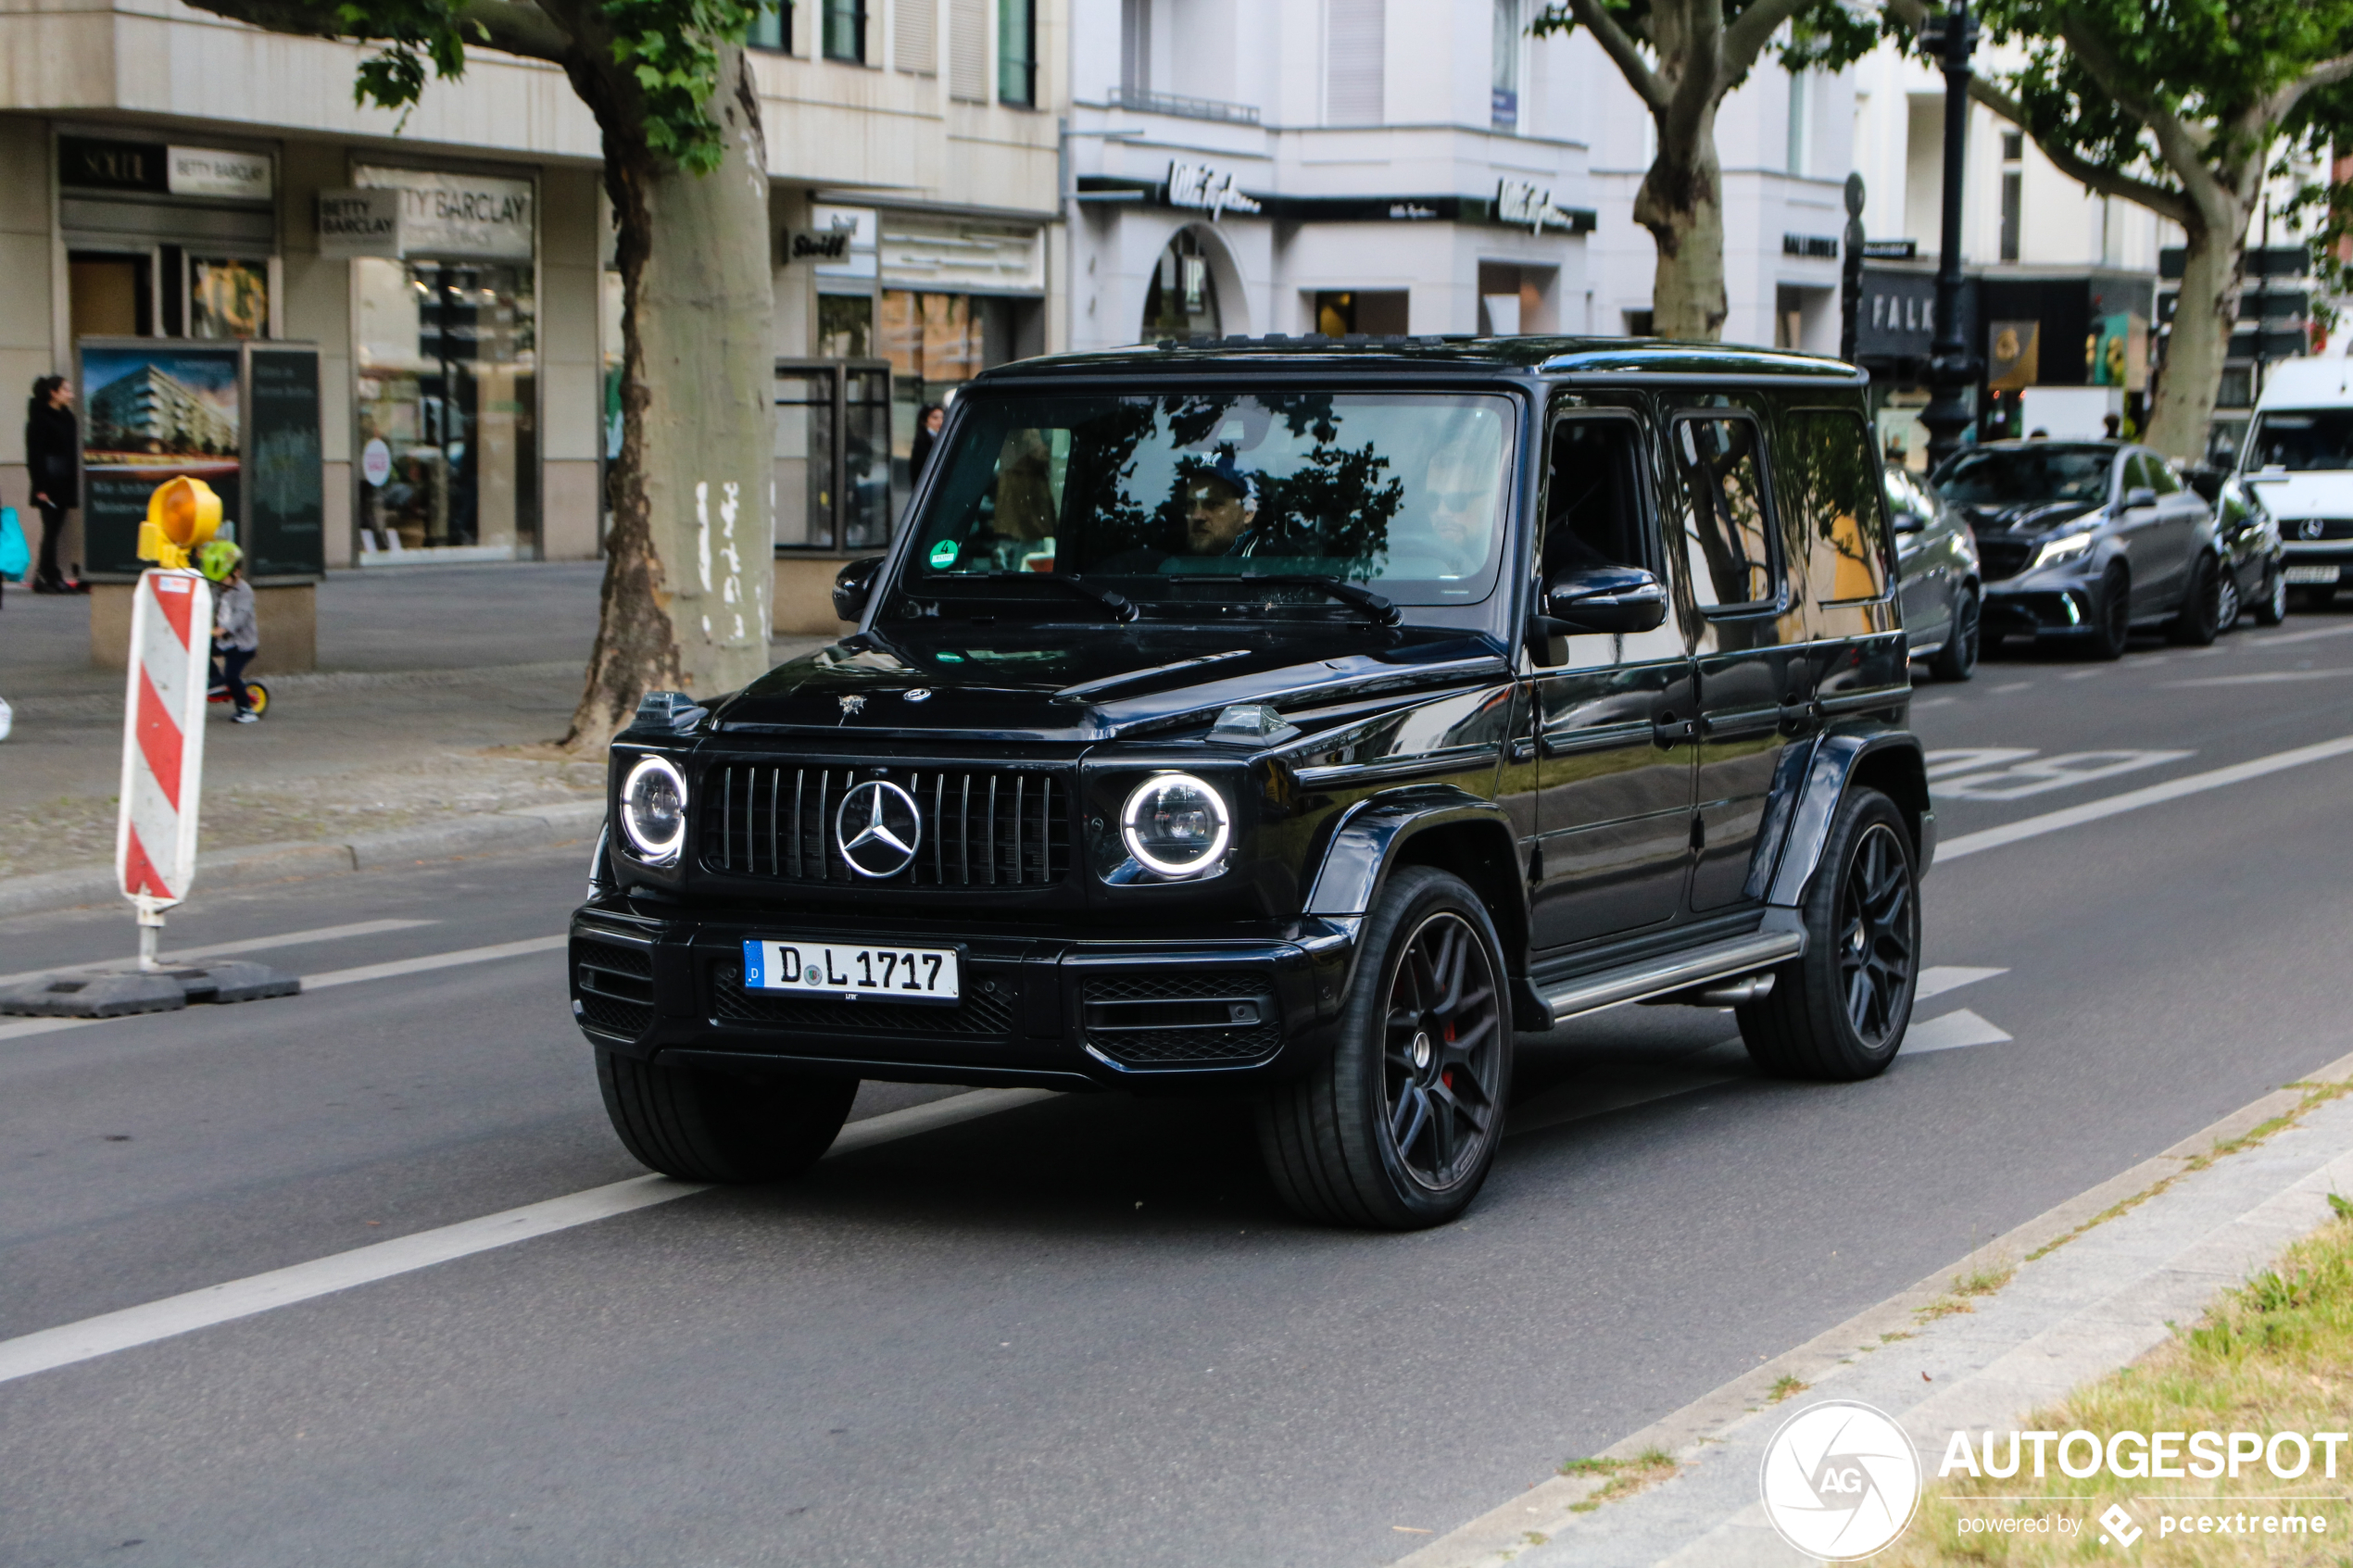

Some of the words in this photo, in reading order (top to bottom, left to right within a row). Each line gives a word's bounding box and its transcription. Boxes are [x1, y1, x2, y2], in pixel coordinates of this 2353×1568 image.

[435, 190, 526, 225] BARCLAY
[321, 216, 394, 234] BARCLAY
[1872, 295, 1934, 332] FALK
[940, 541, 949, 554] 4
[750, 968, 759, 979] D
[779, 946, 801, 983] D
[824, 948, 848, 985] L
[856, 950, 943, 990] 1717
